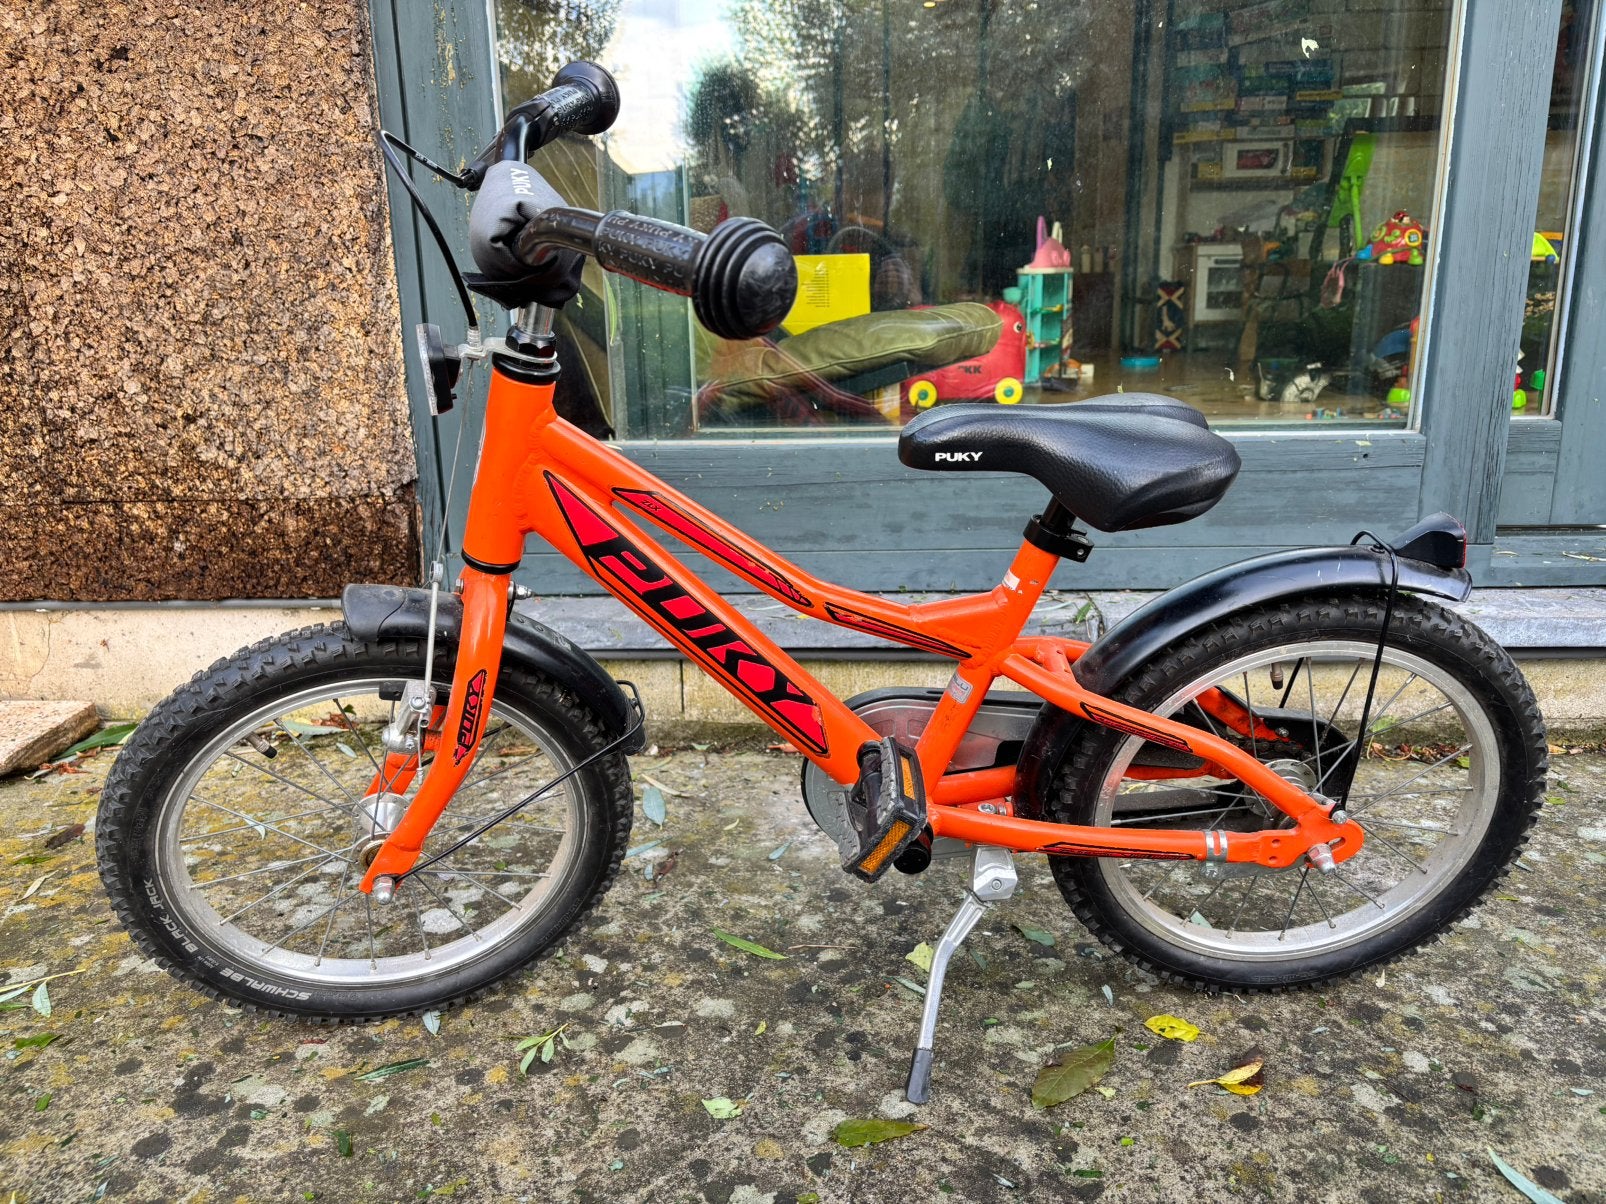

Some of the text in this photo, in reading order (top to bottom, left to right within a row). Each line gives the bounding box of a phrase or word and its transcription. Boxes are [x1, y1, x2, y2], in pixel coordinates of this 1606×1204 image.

[510, 167, 534, 196] PUKY
[934, 451, 984, 462] PUKY
[583, 535, 816, 706] PUKY
[457, 680, 481, 748] PUKY
[143, 878, 313, 1001] SCHWALBE BLACK JACK
